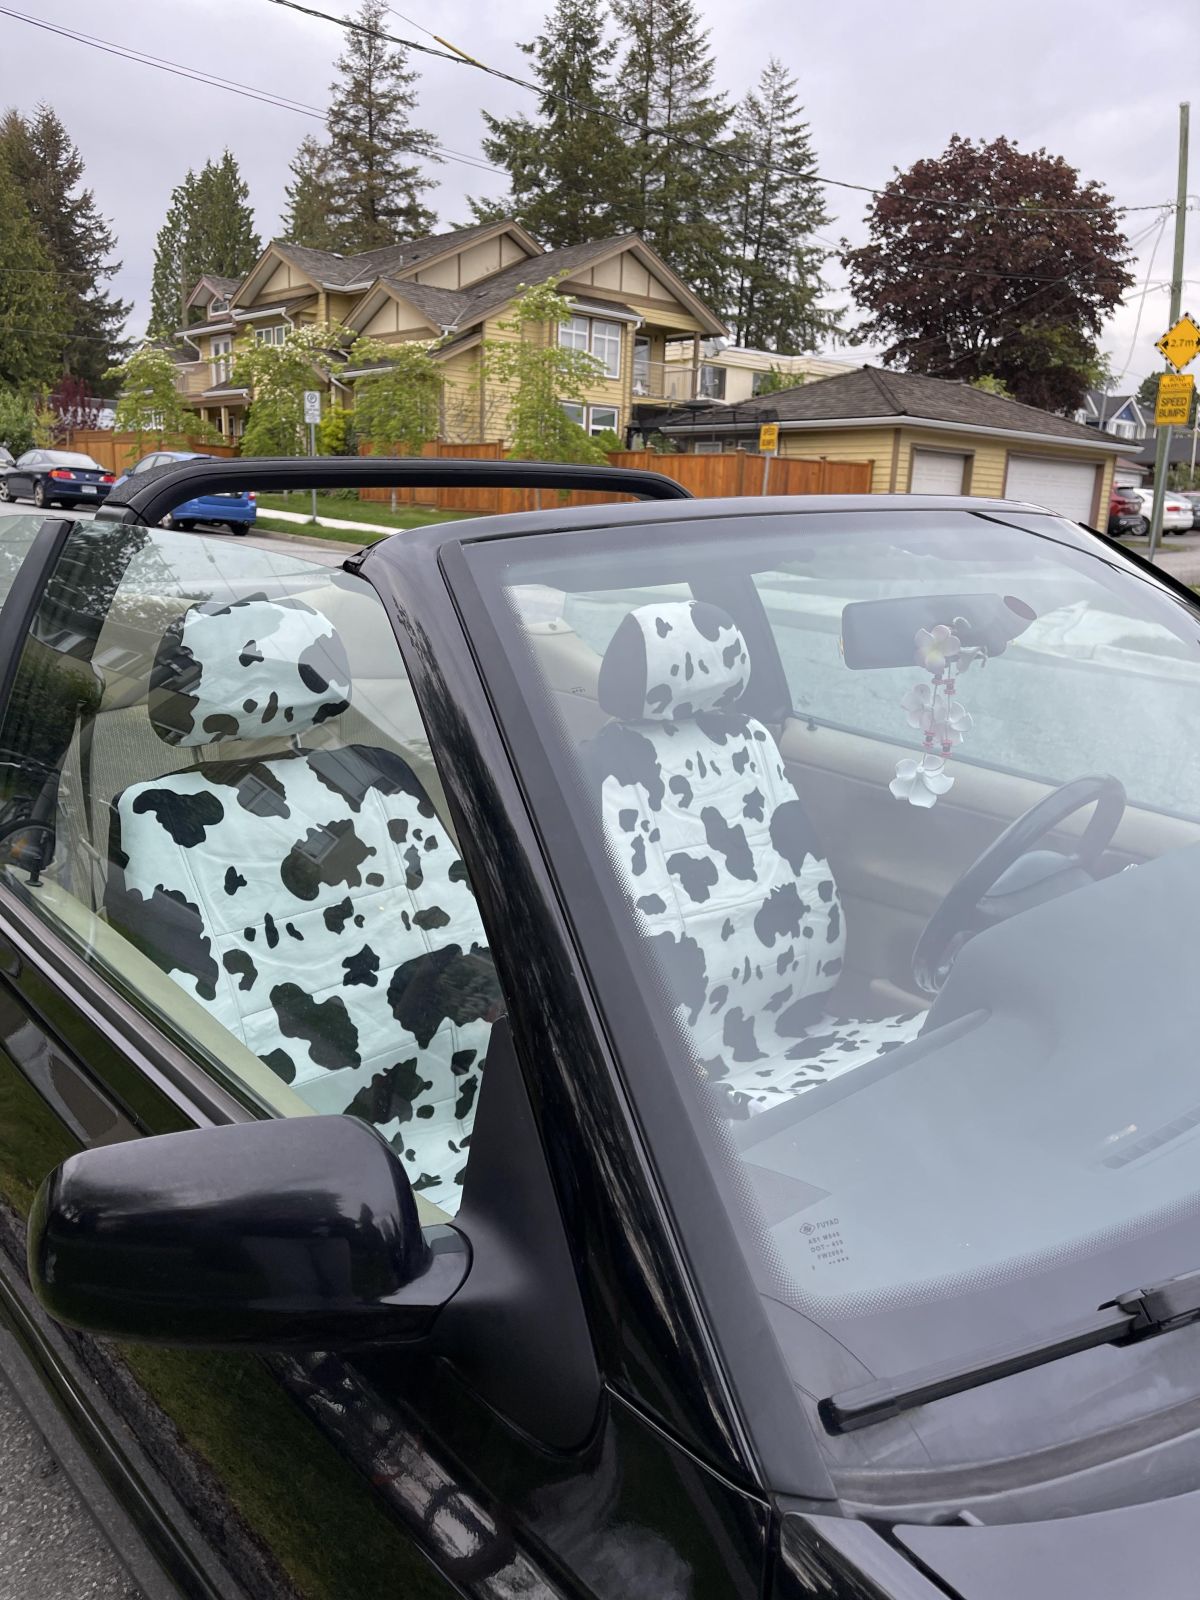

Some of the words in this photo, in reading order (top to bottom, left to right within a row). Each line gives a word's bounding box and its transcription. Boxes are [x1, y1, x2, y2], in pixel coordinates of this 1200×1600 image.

[1161, 397, 1187, 407] SPEED
[1159, 408, 1186, 418] BUMPS
[816, 1217, 839, 1230] FUYAO
